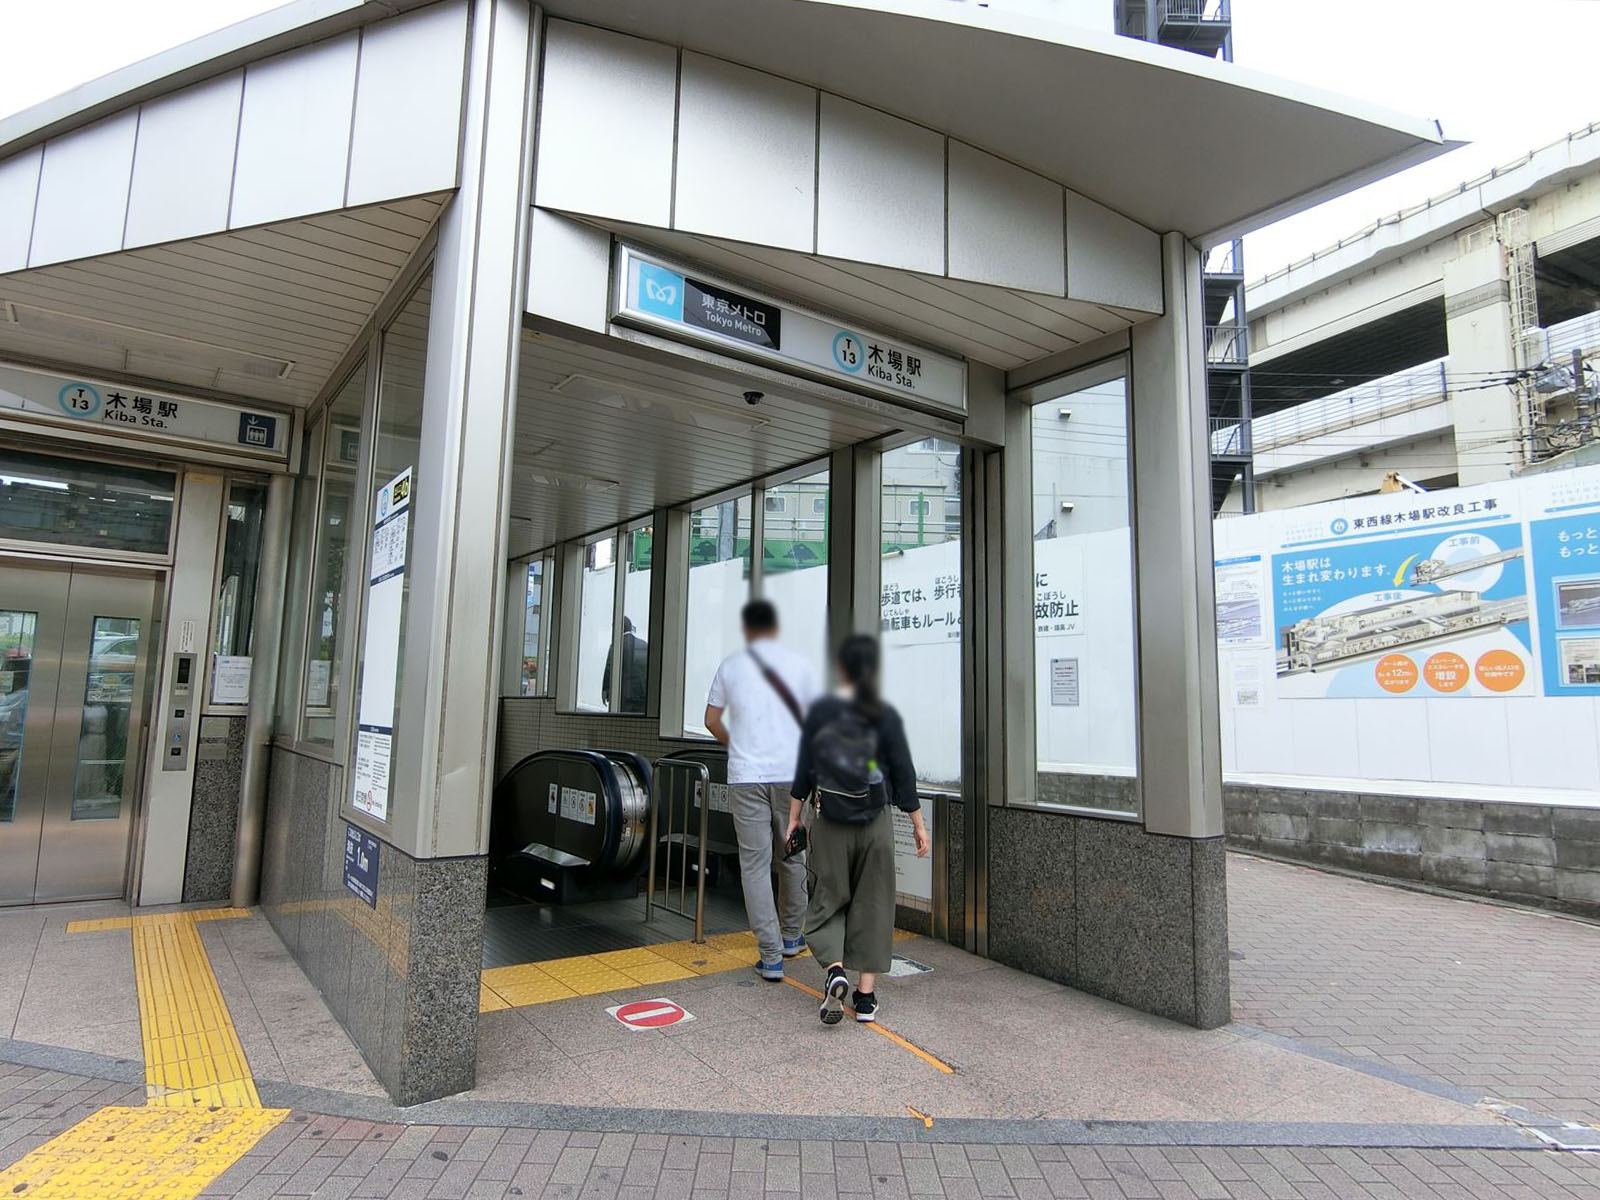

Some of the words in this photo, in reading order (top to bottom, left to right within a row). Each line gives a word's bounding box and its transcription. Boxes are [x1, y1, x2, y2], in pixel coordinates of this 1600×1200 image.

[701, 292, 766, 326] 東京メトロ
[705, 310, 732, 329] Tokyo
[734, 320, 763, 337] Metro
[844, 338, 853, 350] T
[841, 350, 857, 365] 13
[867, 344, 922, 377] 木場駅
[867, 363, 894, 383] Kiba
[895, 372, 916, 389] Sta.
[77, 388, 85, 398] T
[71, 398, 89, 410] 13
[106, 392, 179, 419] 木場駅
[105, 409, 136, 424] Kiba
[141, 415, 169, 429] Sta.
[1353, 498, 1498, 530] 東西線木場駅改良工事
[1558, 528, 1597, 542] もっと
[1559, 543, 1599, 558] もっと
[1281, 557, 1331, 573] 木場駅は
[1282, 563, 1391, 586] 生まれ変わります。
[1035, 573, 1048, 588] に
[1034, 599, 1079, 619] 故防止
